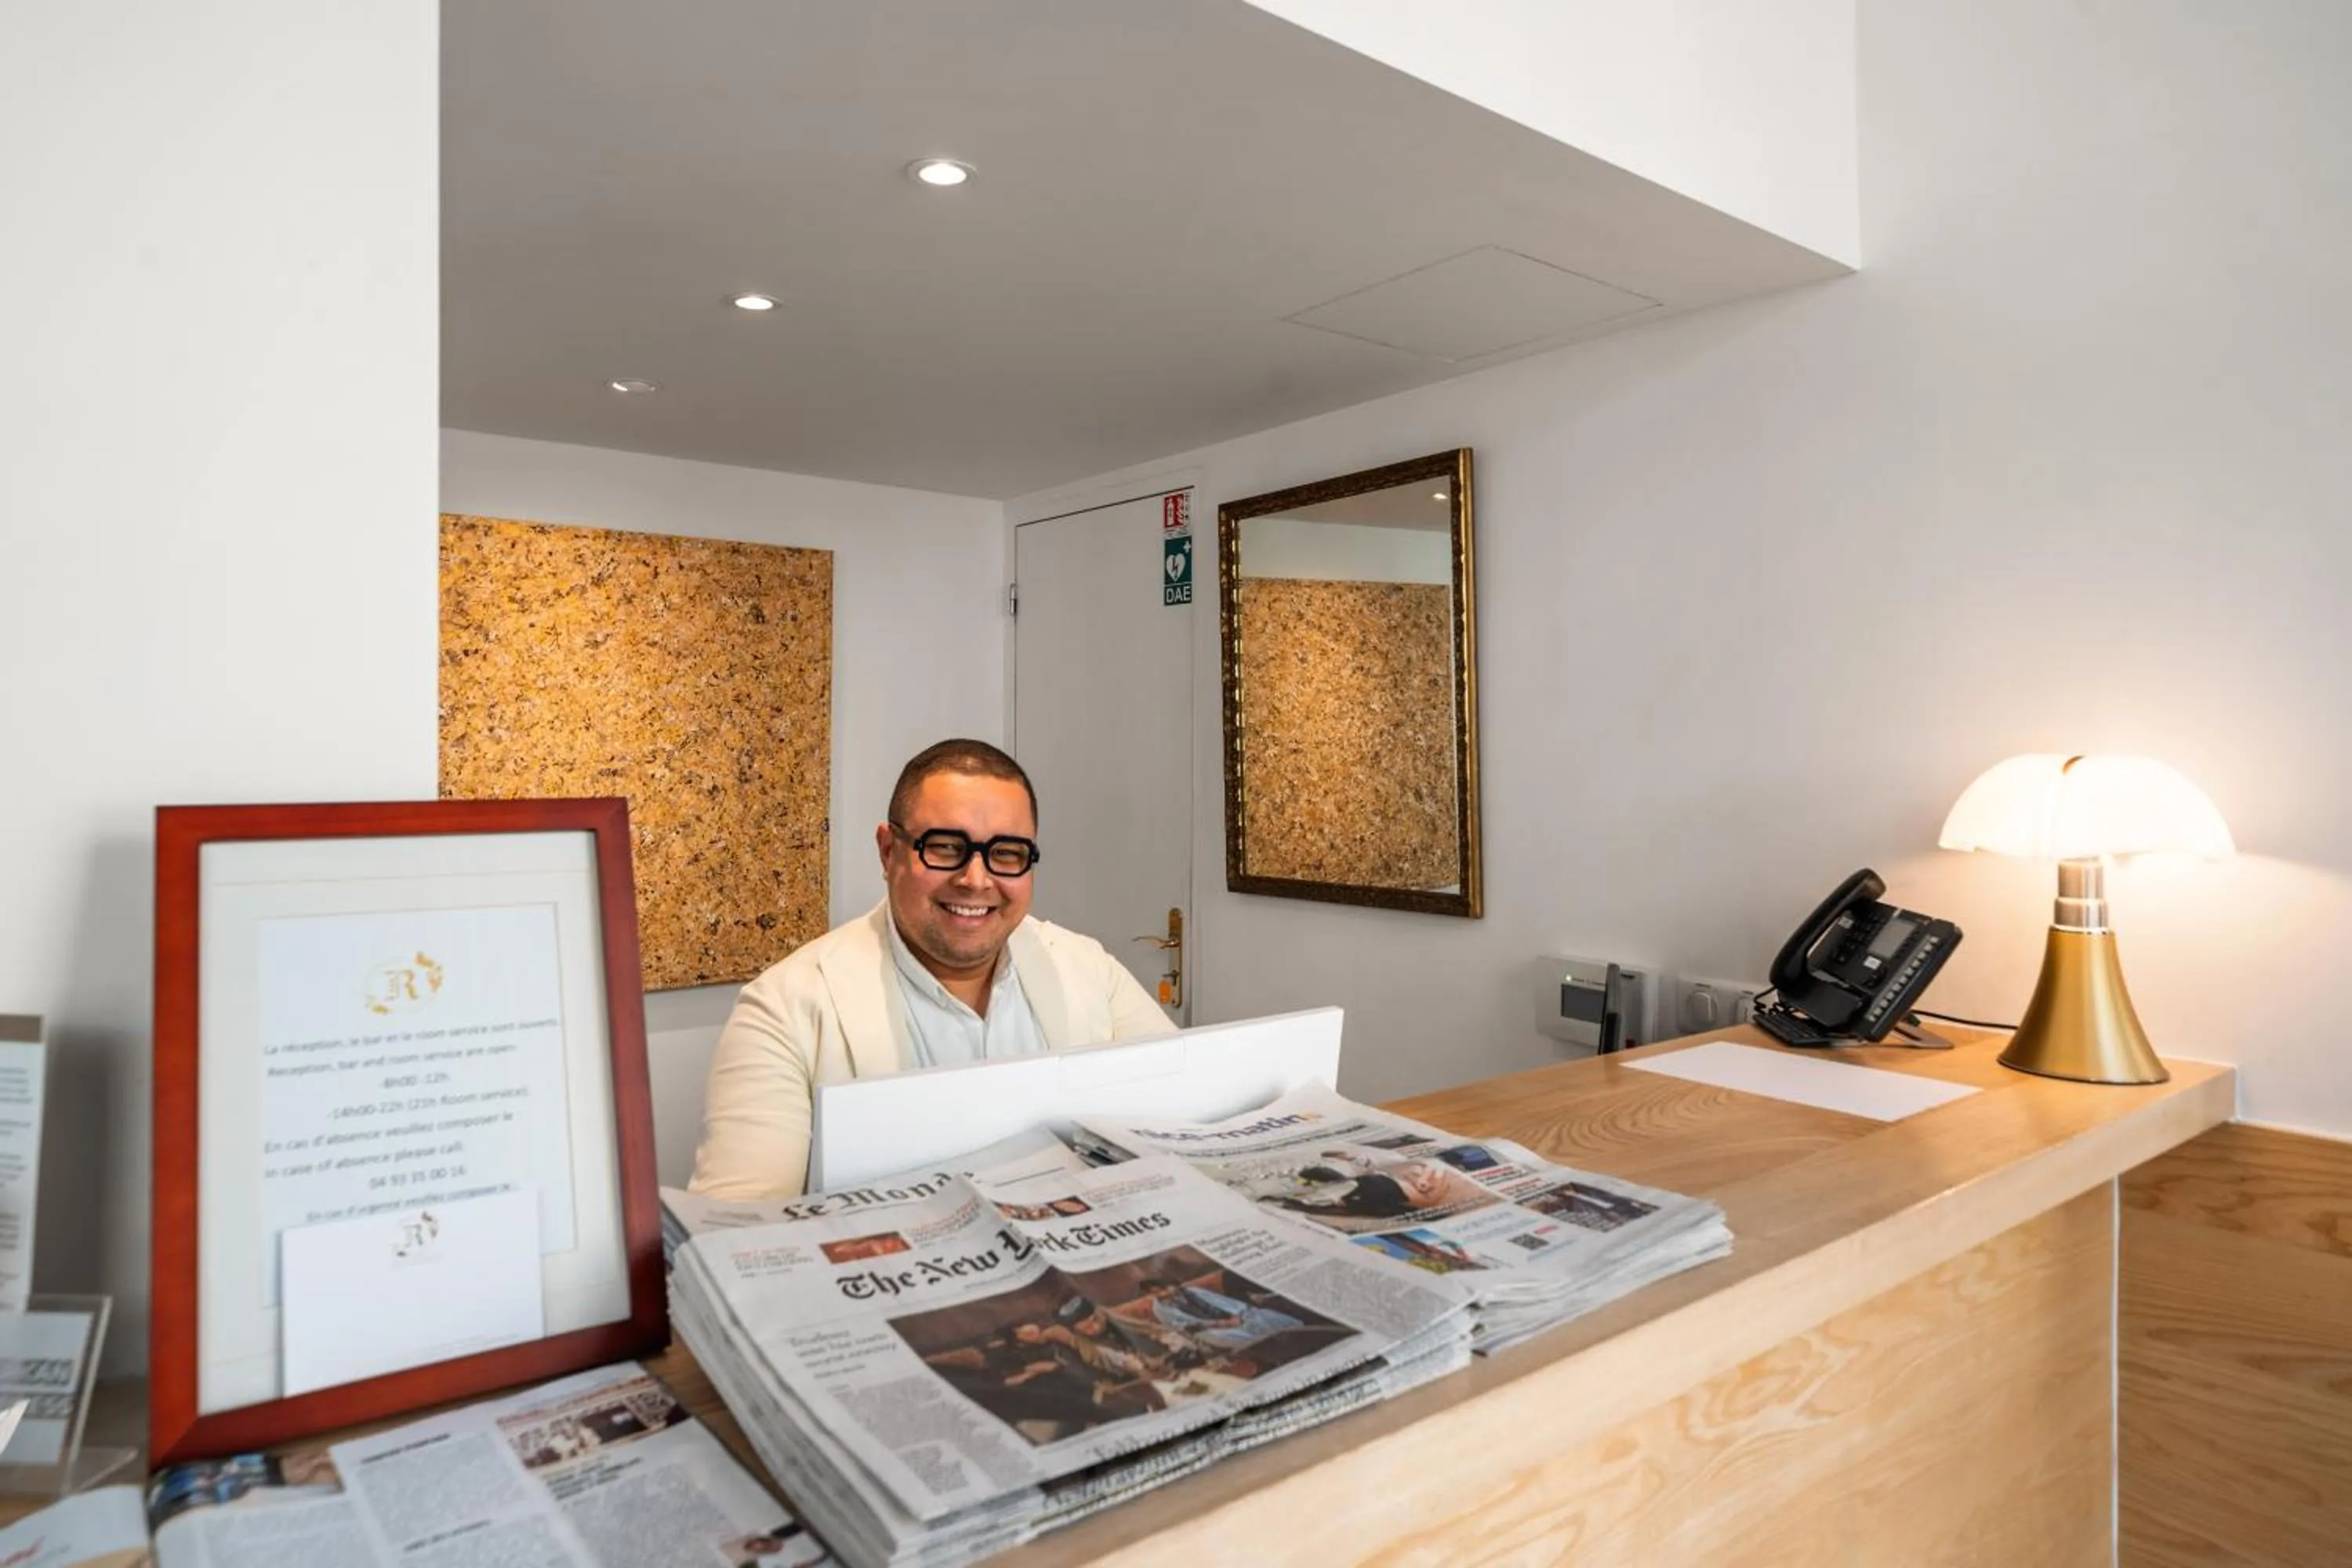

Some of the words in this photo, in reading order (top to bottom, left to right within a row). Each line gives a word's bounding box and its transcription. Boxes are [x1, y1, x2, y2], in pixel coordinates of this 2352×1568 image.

[1166, 586, 1192, 604] DAE
[448, 1025, 488, 1036] service
[424, 1051, 463, 1061] service
[836, 1270, 917, 1300] The
[915, 1248, 1000, 1284] New
[1069, 1211, 1172, 1247] Times
